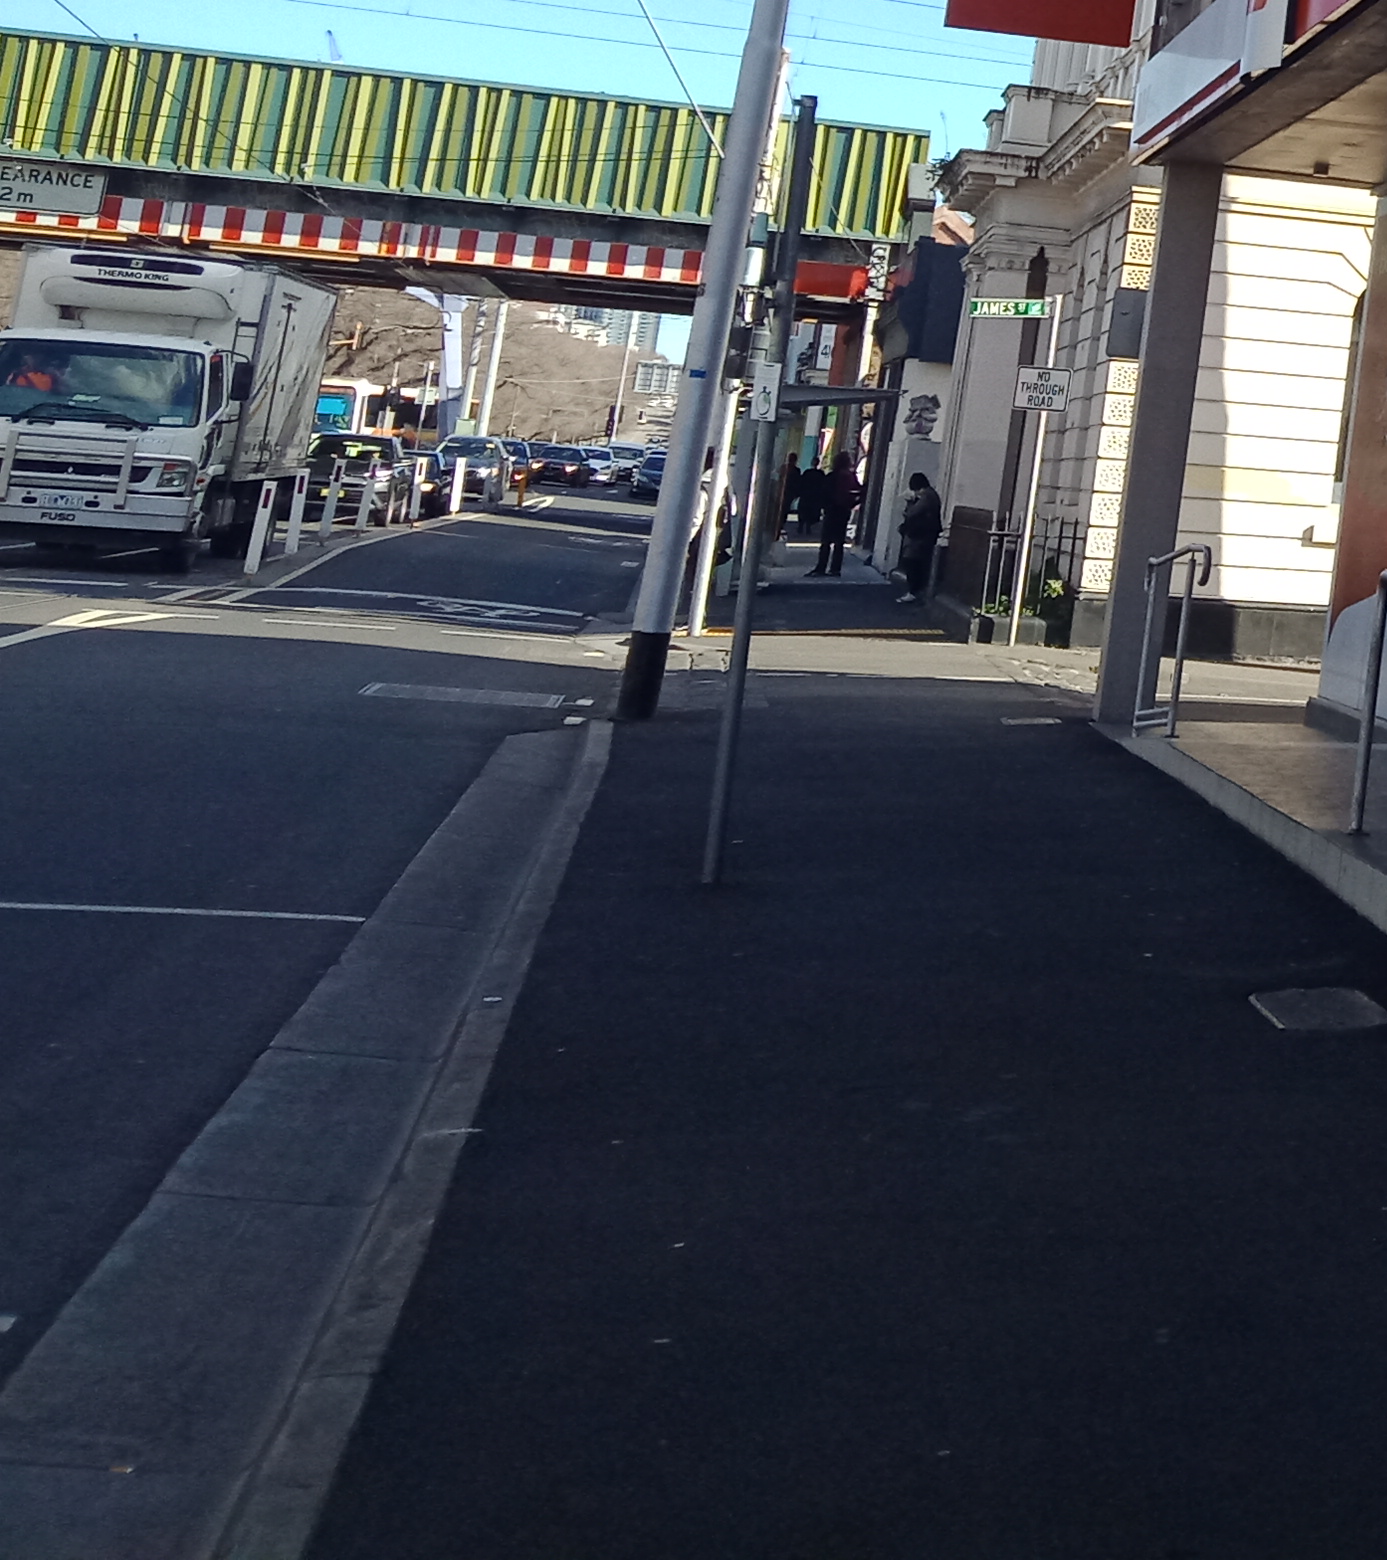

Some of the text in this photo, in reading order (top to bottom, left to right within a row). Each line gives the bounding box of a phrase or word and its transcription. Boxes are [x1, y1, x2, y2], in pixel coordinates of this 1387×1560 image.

[16, 192, 34, 204] m
[97, 269, 169, 282] THERMO KING
[973, 301, 1015, 315] JAMES
[1037, 371, 1050, 382] NO
[1020, 382, 1065, 396] THROUGH
[1027, 395, 1054, 408] ROAD
[41, 512, 76, 522] FUSO
